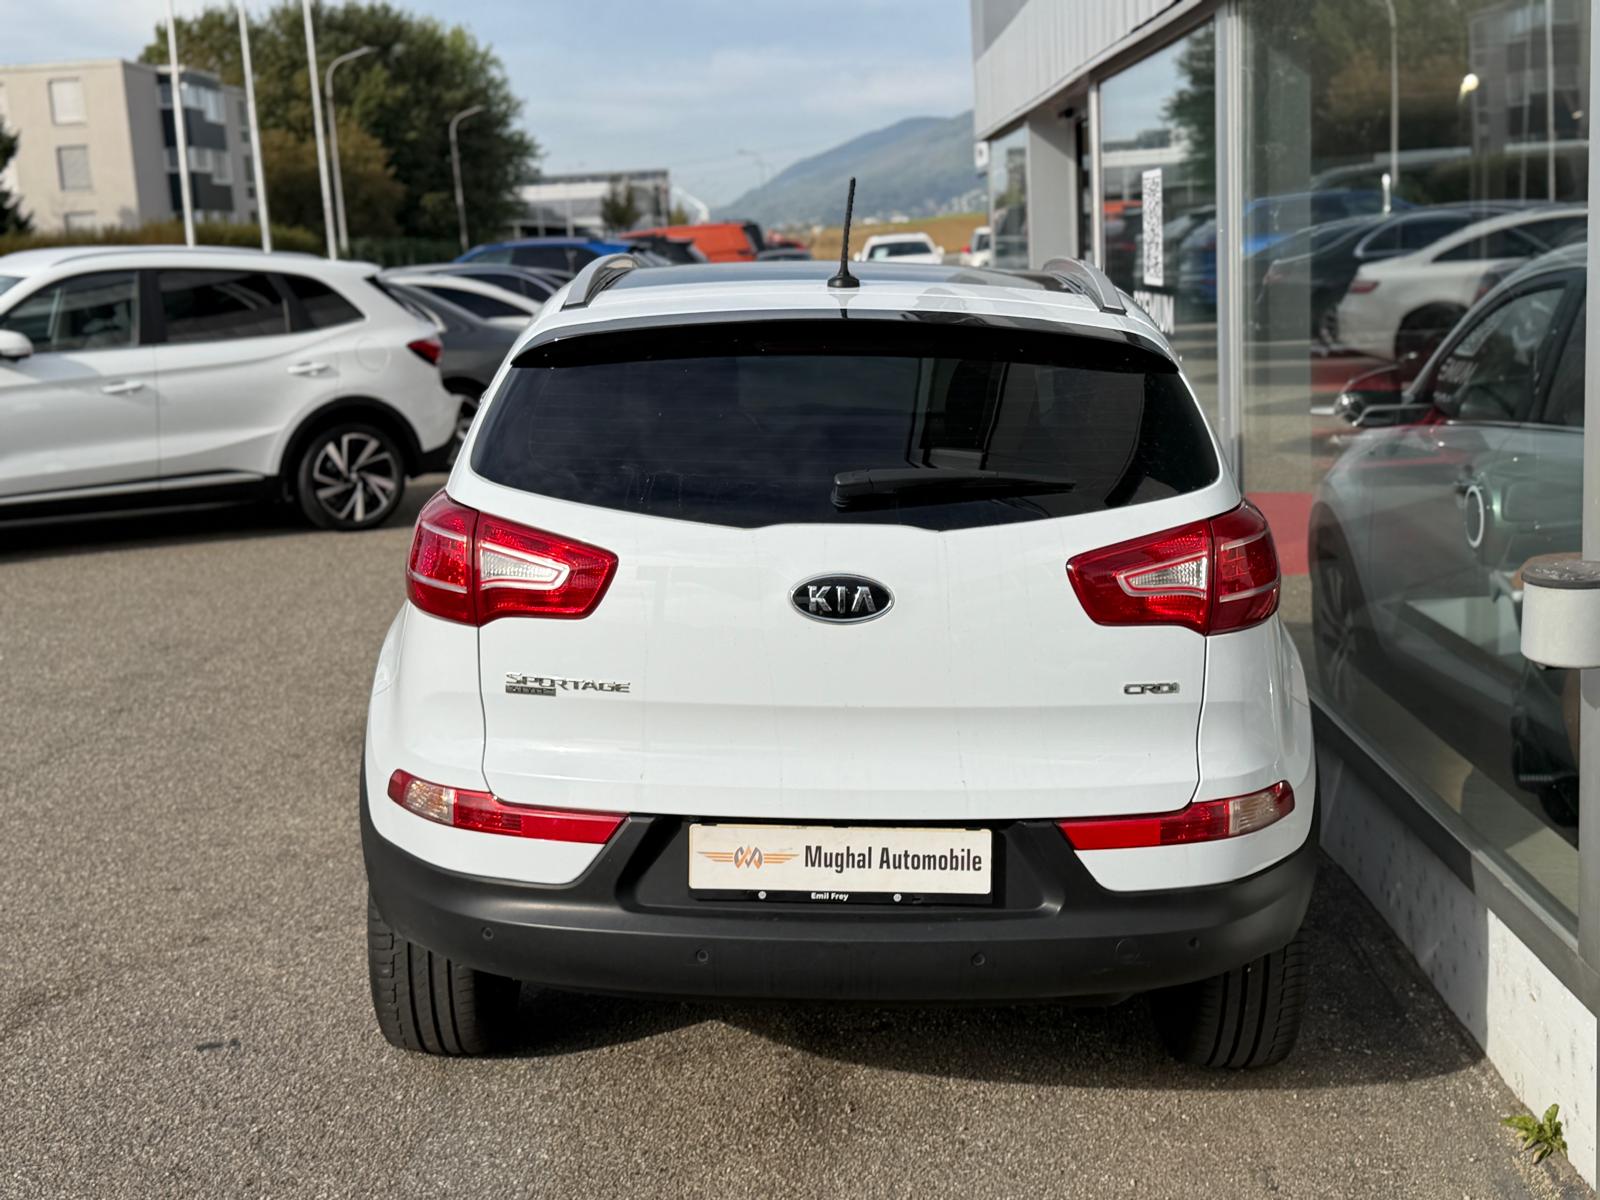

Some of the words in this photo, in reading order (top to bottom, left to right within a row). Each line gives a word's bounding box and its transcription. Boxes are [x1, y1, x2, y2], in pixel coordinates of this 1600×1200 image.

[807, 585, 877, 613] KIA
[506, 671, 631, 694] SPORTAGE
[804, 845, 873, 874] Mughal
[879, 847, 983, 872] Automobile
[811, 892, 830, 900] Emil
[830, 892, 849, 902] Frey
